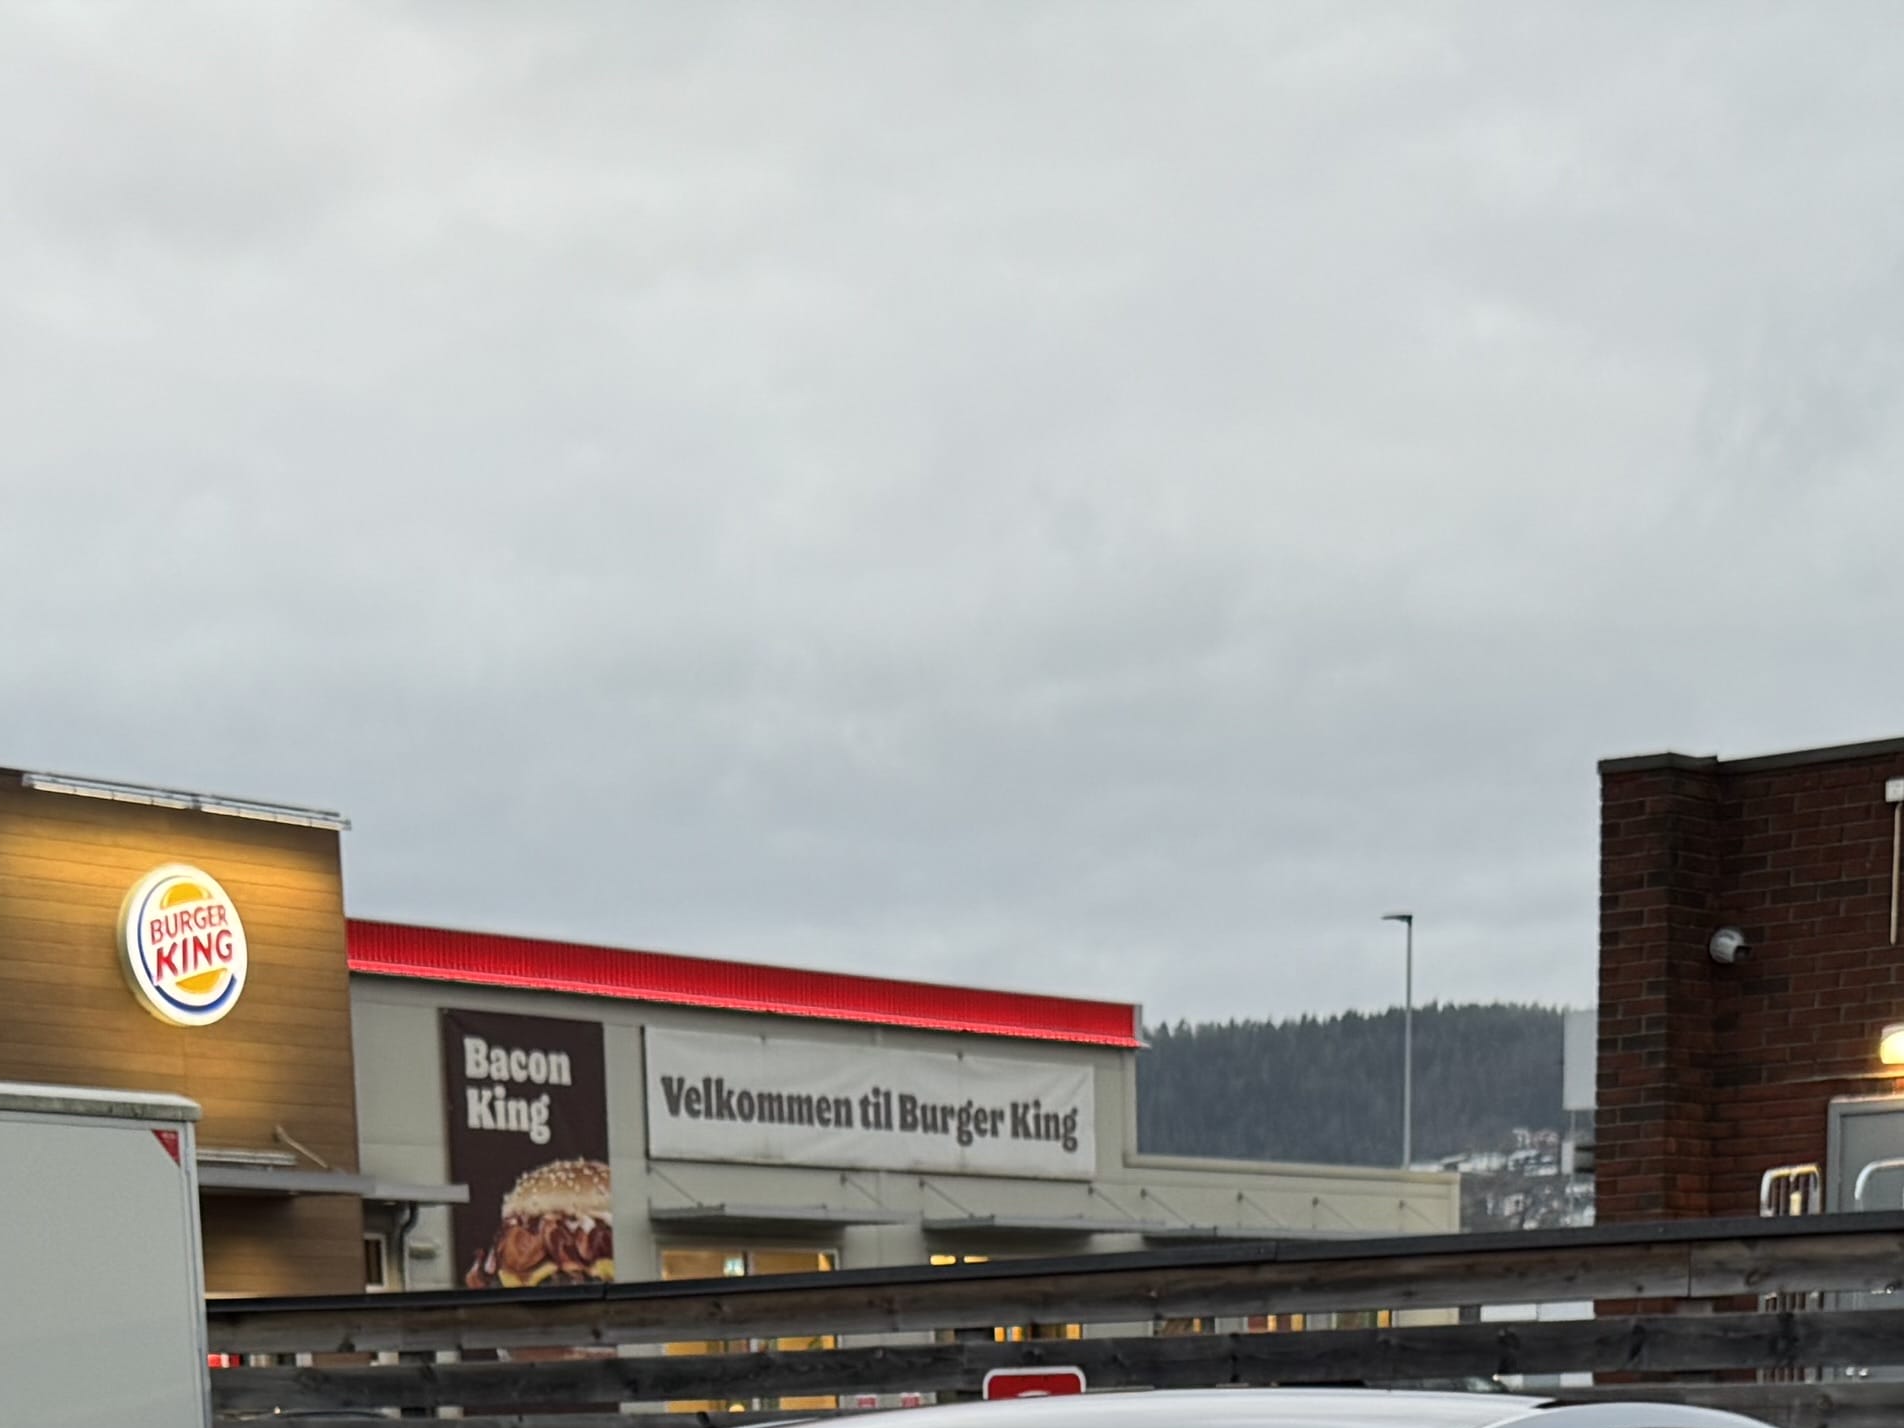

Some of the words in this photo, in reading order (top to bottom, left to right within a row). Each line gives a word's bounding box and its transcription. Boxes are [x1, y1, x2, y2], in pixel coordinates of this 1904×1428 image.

[150, 904, 228, 945] BURGER
[156, 929, 233, 982] KING
[463, 1036, 572, 1087] Bacon
[466, 1084, 551, 1144] King
[660, 1075, 853, 1129] Velkommen
[859, 1086, 894, 1132] til
[899, 1093, 1005, 1147] Burger
[1010, 1099, 1078, 1153] King
